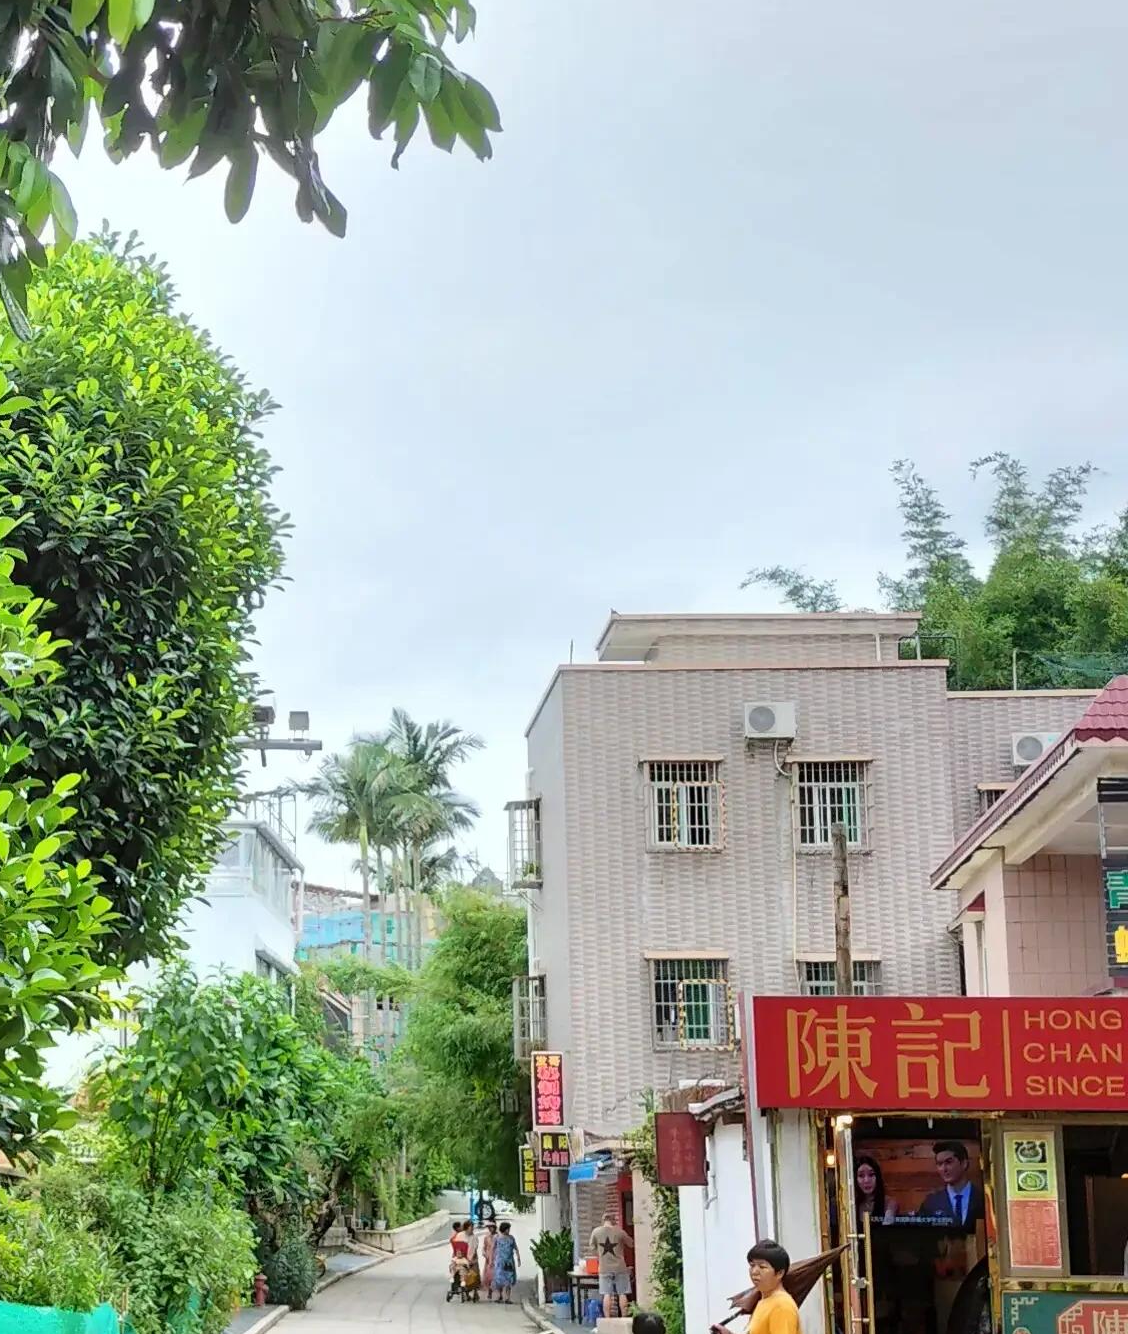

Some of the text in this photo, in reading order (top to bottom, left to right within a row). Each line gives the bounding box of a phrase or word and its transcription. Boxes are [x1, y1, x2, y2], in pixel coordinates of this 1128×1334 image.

[1023, 1009, 1122, 1030] HONG
[786, 1002, 990, 1099] 陳記
[1023, 1042, 1122, 1063] CHAN
[1025, 1075, 1126, 1096] SINCE
